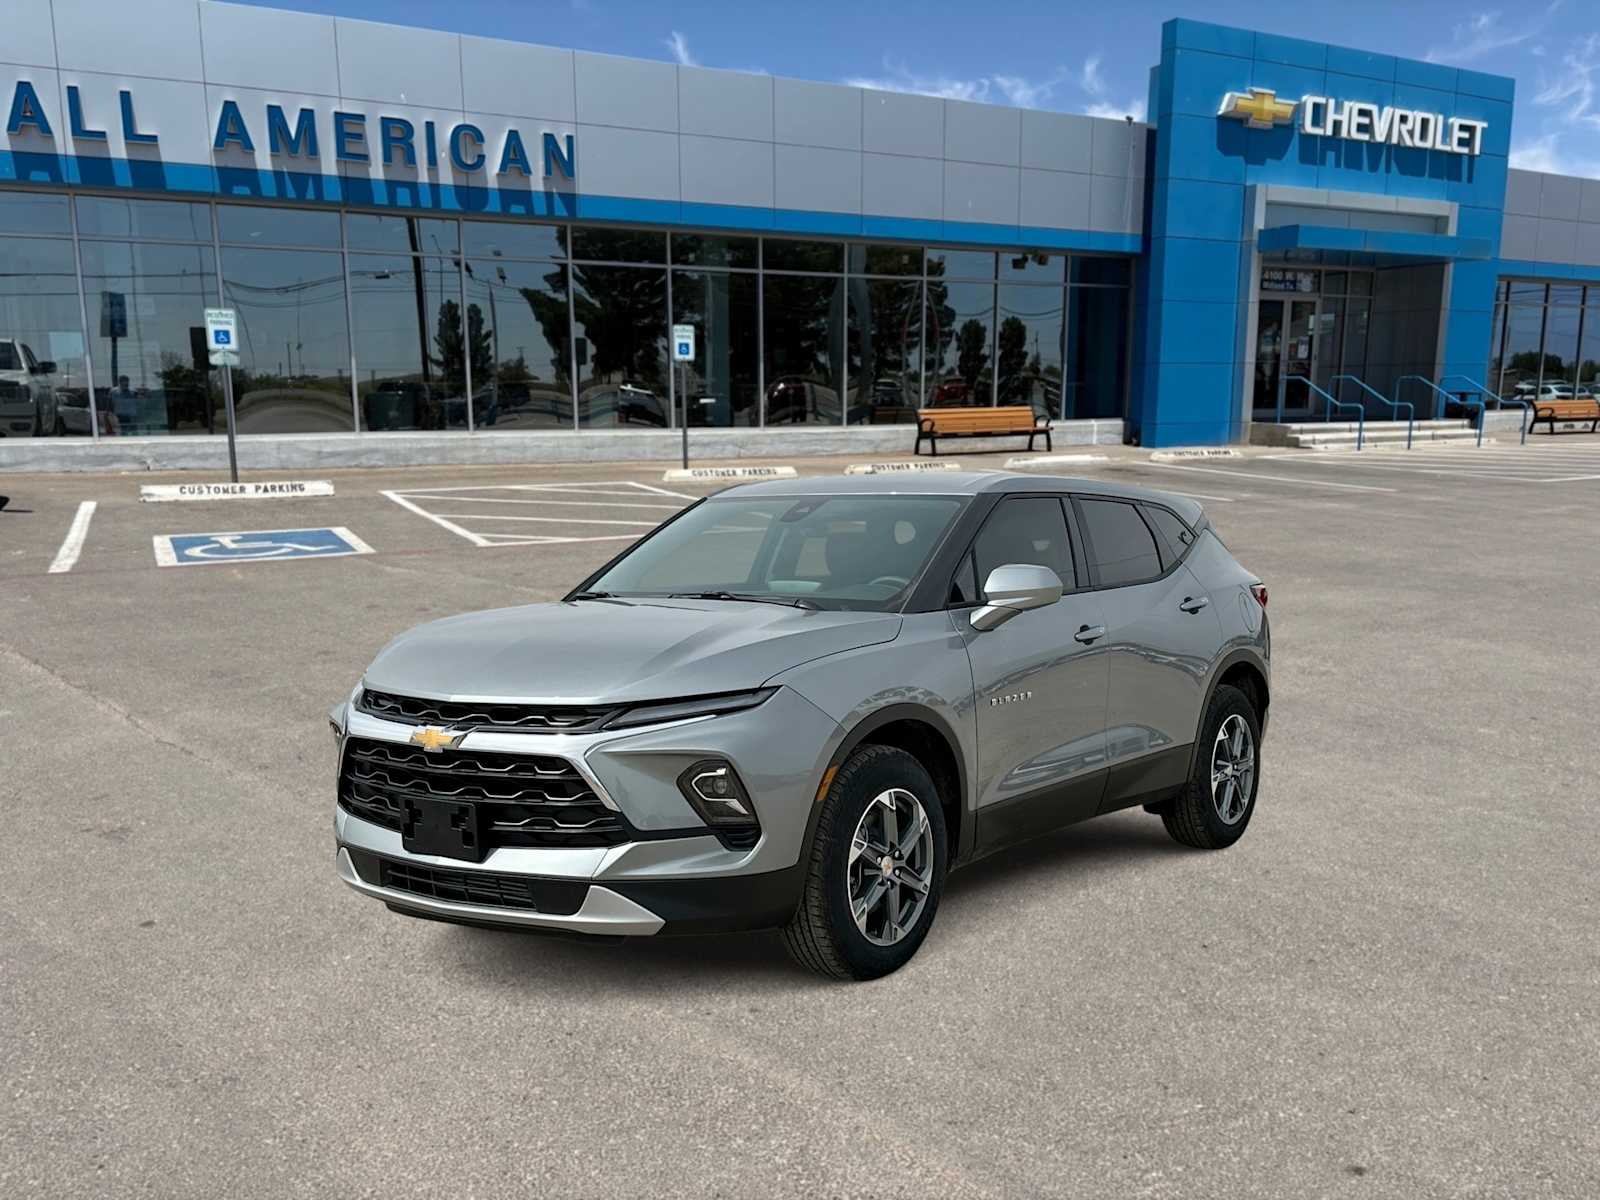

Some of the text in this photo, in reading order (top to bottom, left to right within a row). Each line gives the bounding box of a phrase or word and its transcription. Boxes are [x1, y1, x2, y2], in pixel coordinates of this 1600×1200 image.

[6, 80, 576, 179] ALL AMERICAN
[1301, 94, 1488, 156] CHEVROLET
[179, 483, 306, 496] CUSTOMER PARKING
[691, 468, 777, 477] CUSTOMER PARKING
